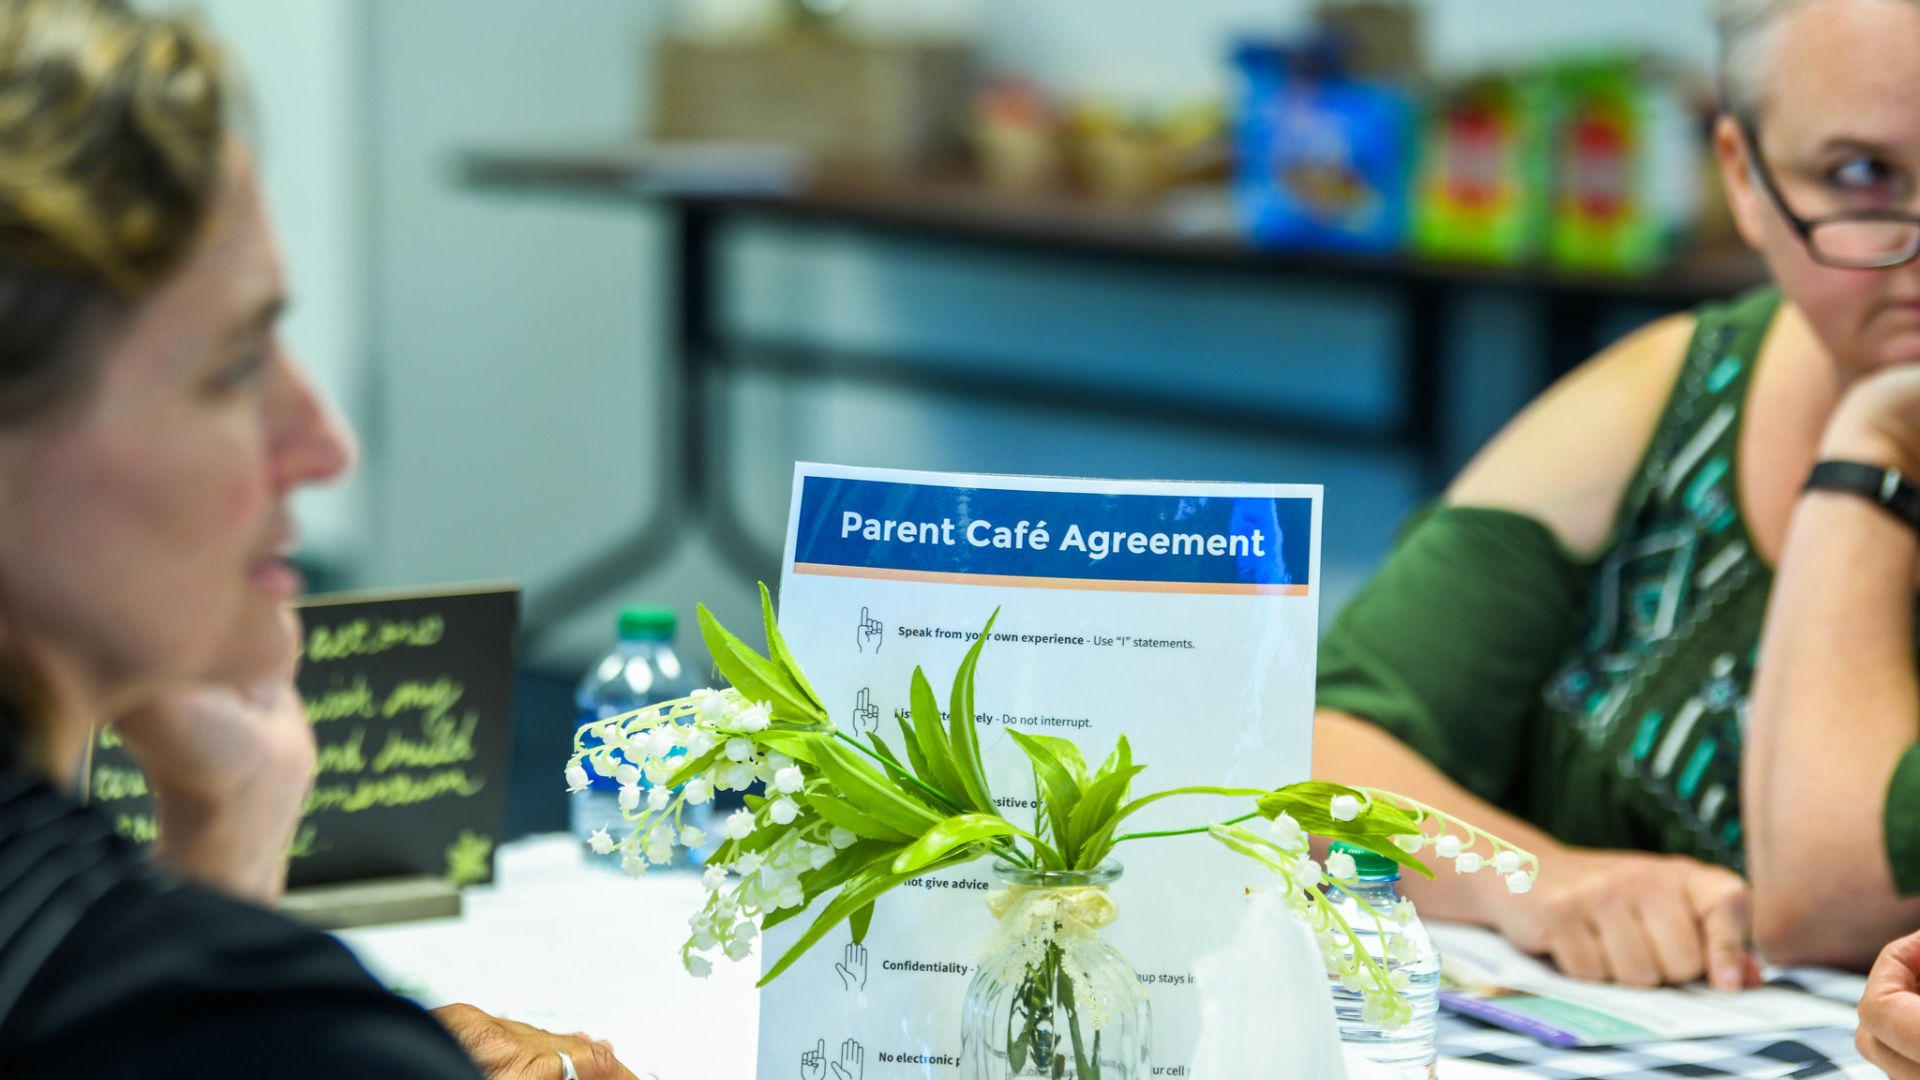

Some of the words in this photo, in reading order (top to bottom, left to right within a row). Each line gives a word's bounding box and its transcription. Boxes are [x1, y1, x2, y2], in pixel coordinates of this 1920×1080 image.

[841, 511, 956, 546] Parent
[966, 519, 1050, 550] Café
[1059, 524, 1266, 560] Agreement
[898, 626, 932, 638] Speak
[935, 628, 962, 639] from
[994, 633, 1018, 642] own
[1021, 633, 1084, 646] experience
[1093, 635, 1113, 646] Use
[1133, 638, 1196, 649] statements.
[1002, 714, 1017, 724] Do
[1020, 715, 1038, 726] not
[1041, 715, 1092, 730] interrupt.
[925, 877, 949, 890] give
[952, 879, 989, 890] advice
[882, 960, 968, 976] Confidentiality
[1158, 973, 1185, 986] stays
[879, 1052, 894, 1063] No
[896, 1053, 953, 1066] electronic
[1166, 1065, 1184, 1076] cell
